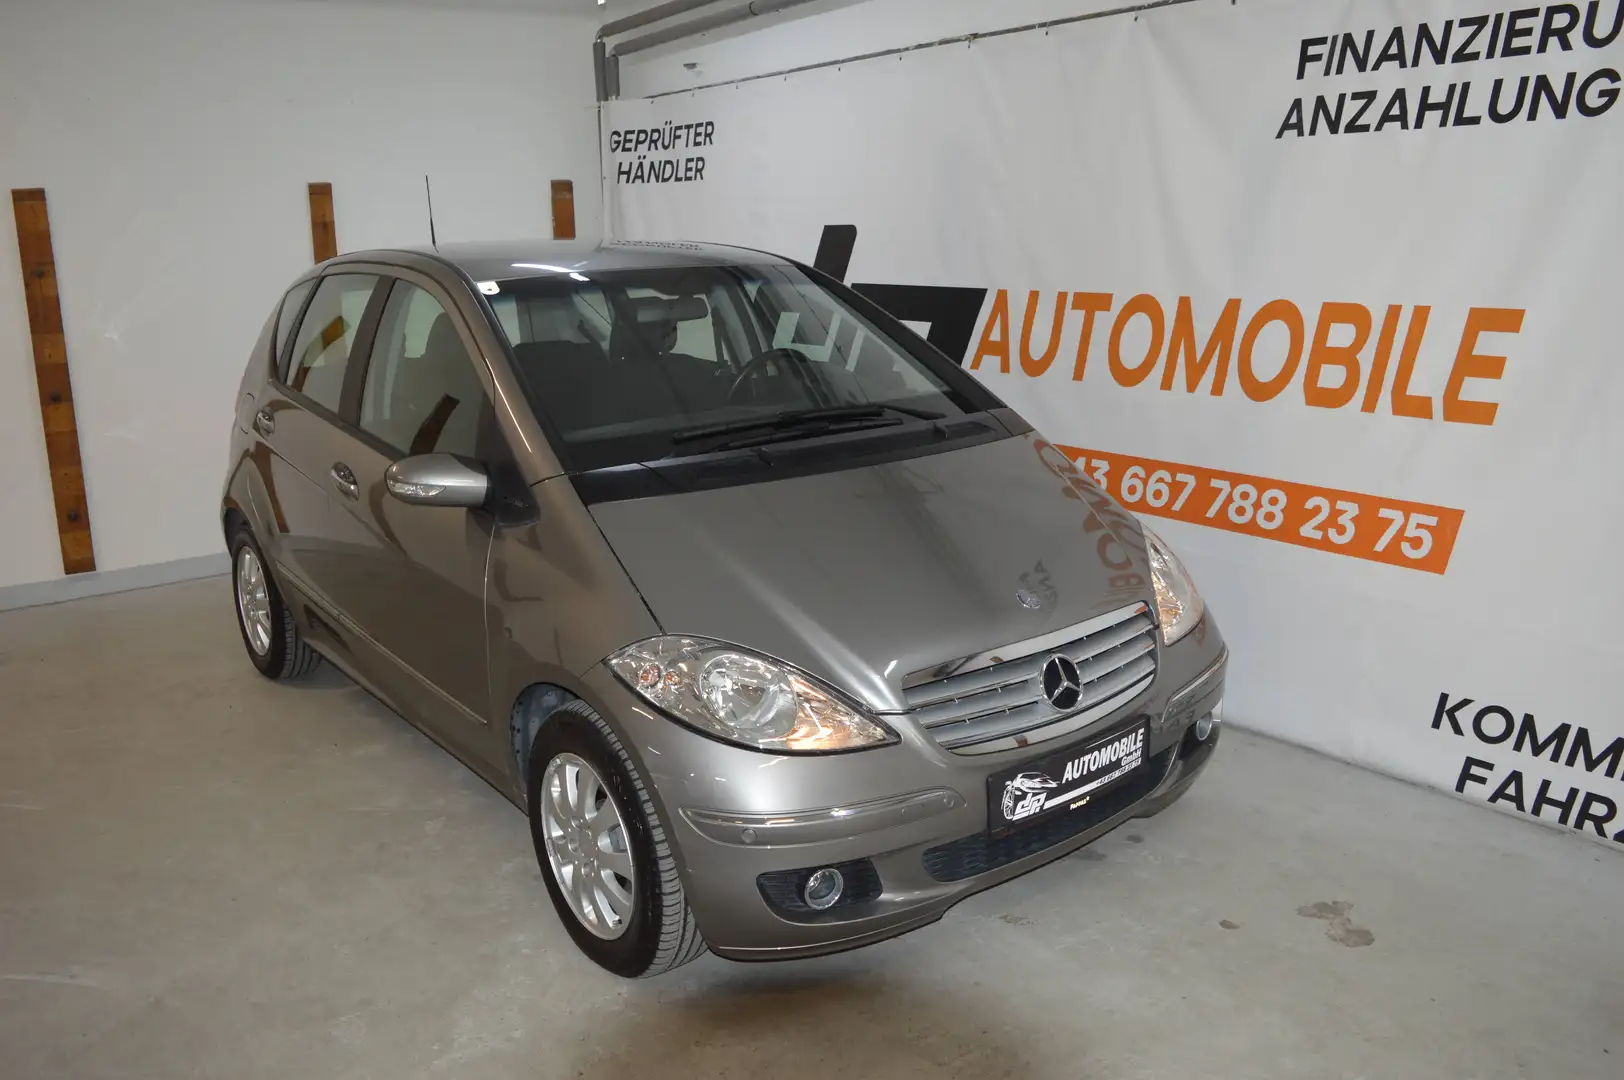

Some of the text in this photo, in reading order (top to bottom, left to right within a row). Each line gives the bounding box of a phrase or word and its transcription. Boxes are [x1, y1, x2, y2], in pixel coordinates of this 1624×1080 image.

[1296, 0, 1624, 80] FINANZIERU
[609, 120, 715, 153] GEPRÜFTER
[1275, 68, 1622, 139] ANZAHLUNG
[616, 155, 706, 184] HÄNDLER
[970, 289, 1526, 426] AUTOMOBILE
[1120, 464, 1197, 511] 667
[1206, 479, 1288, 530] 788
[1299, 496, 1361, 545] 23
[1372, 508, 1438, 559] 75
[1062, 727, 1145, 784] AUTOMOBILE
[1121, 747, 1142, 767] GmbH
[1431, 692, 1624, 781] KOMM
